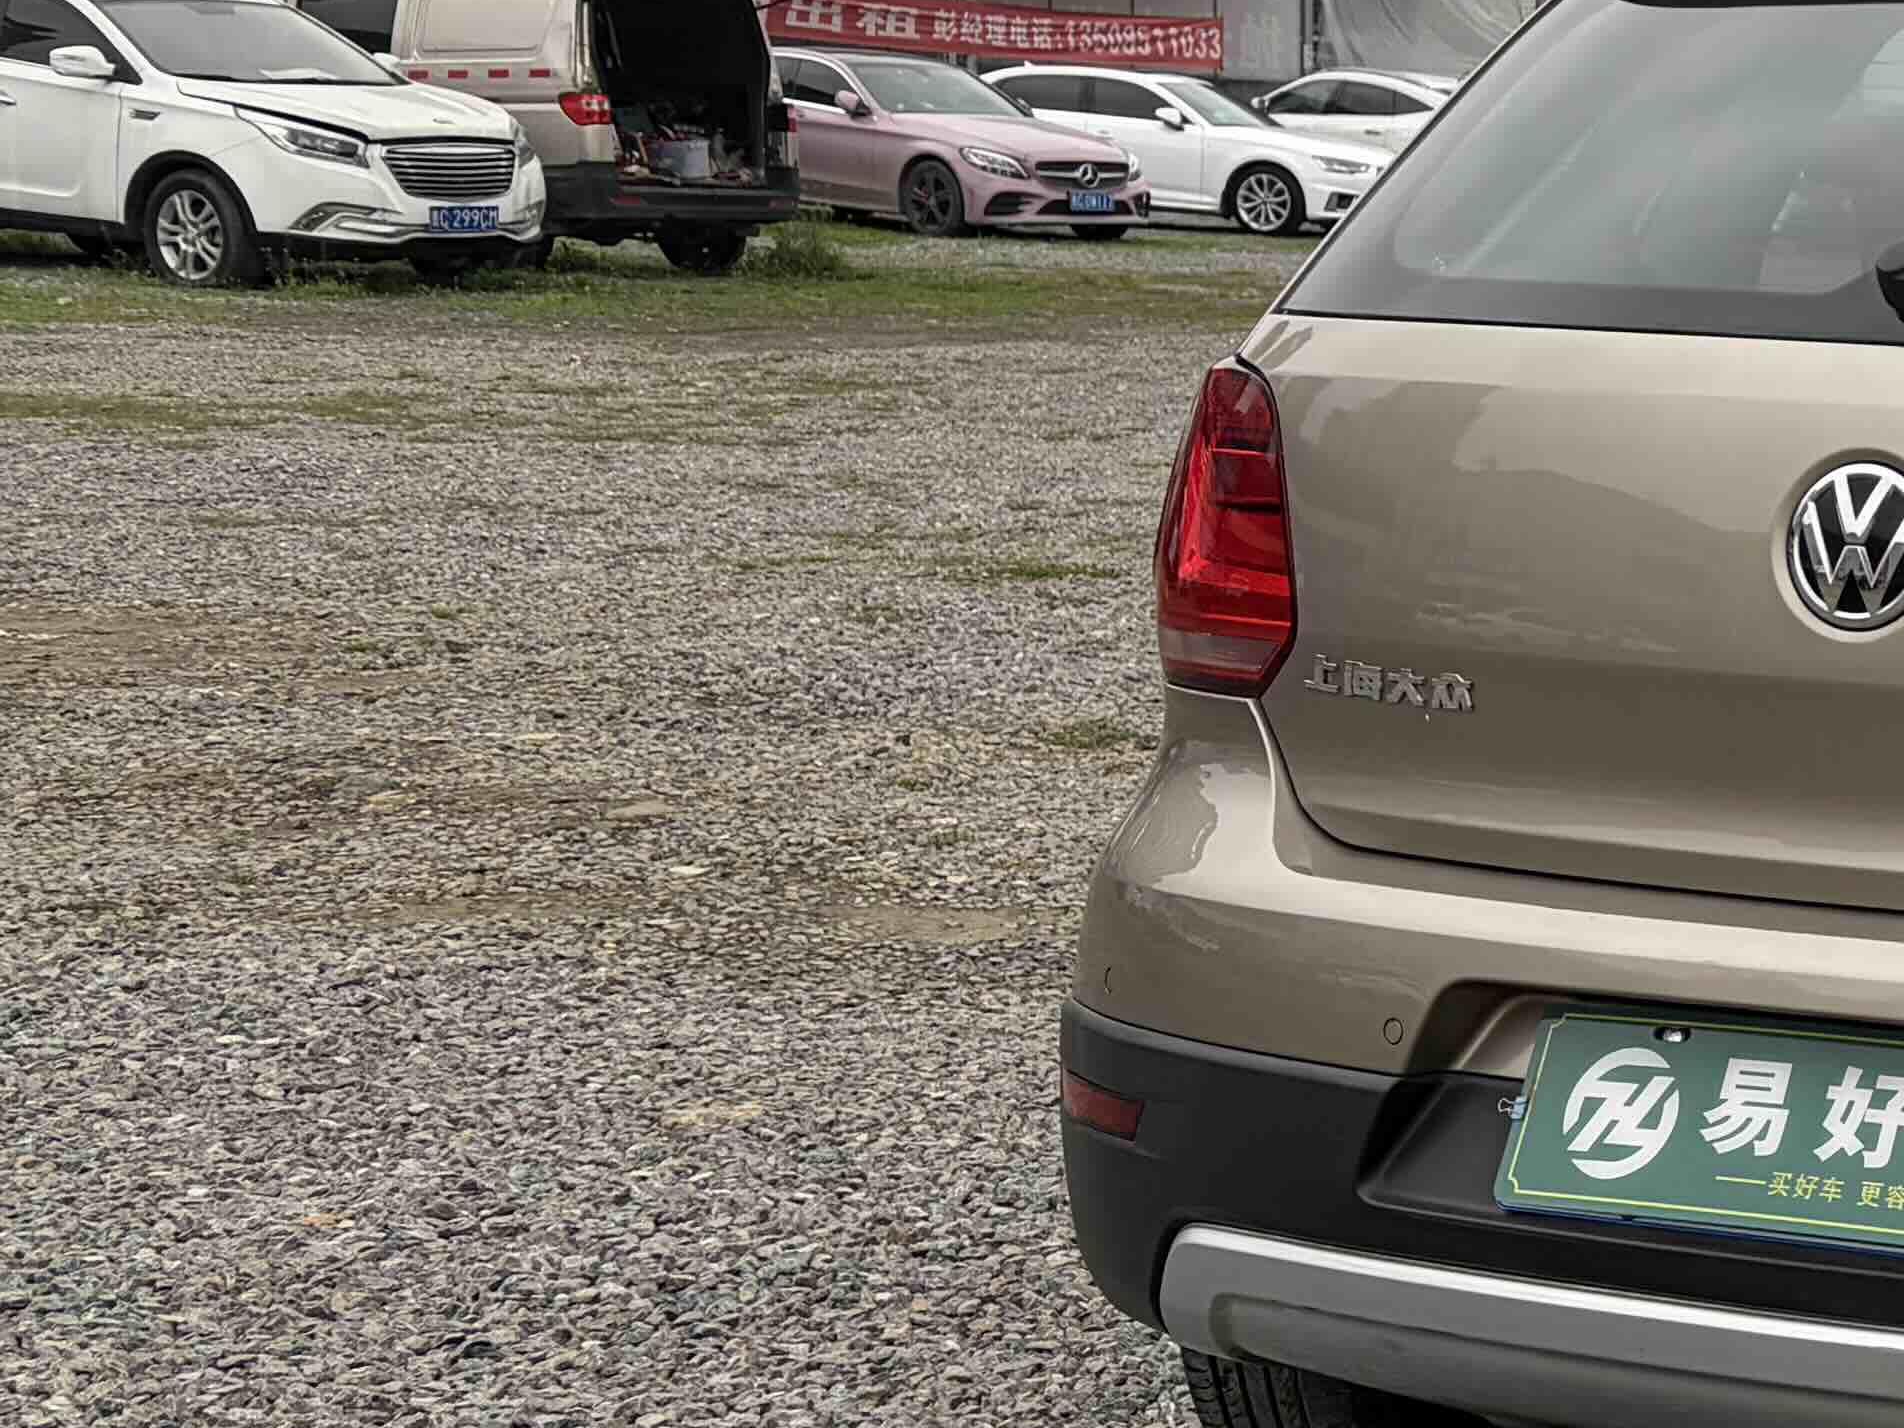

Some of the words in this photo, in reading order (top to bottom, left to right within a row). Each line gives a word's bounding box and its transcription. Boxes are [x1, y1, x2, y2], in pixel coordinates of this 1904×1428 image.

[1303, 653, 1474, 712] 上海大众
[1766, 1171, 1846, 1203] 买好车
